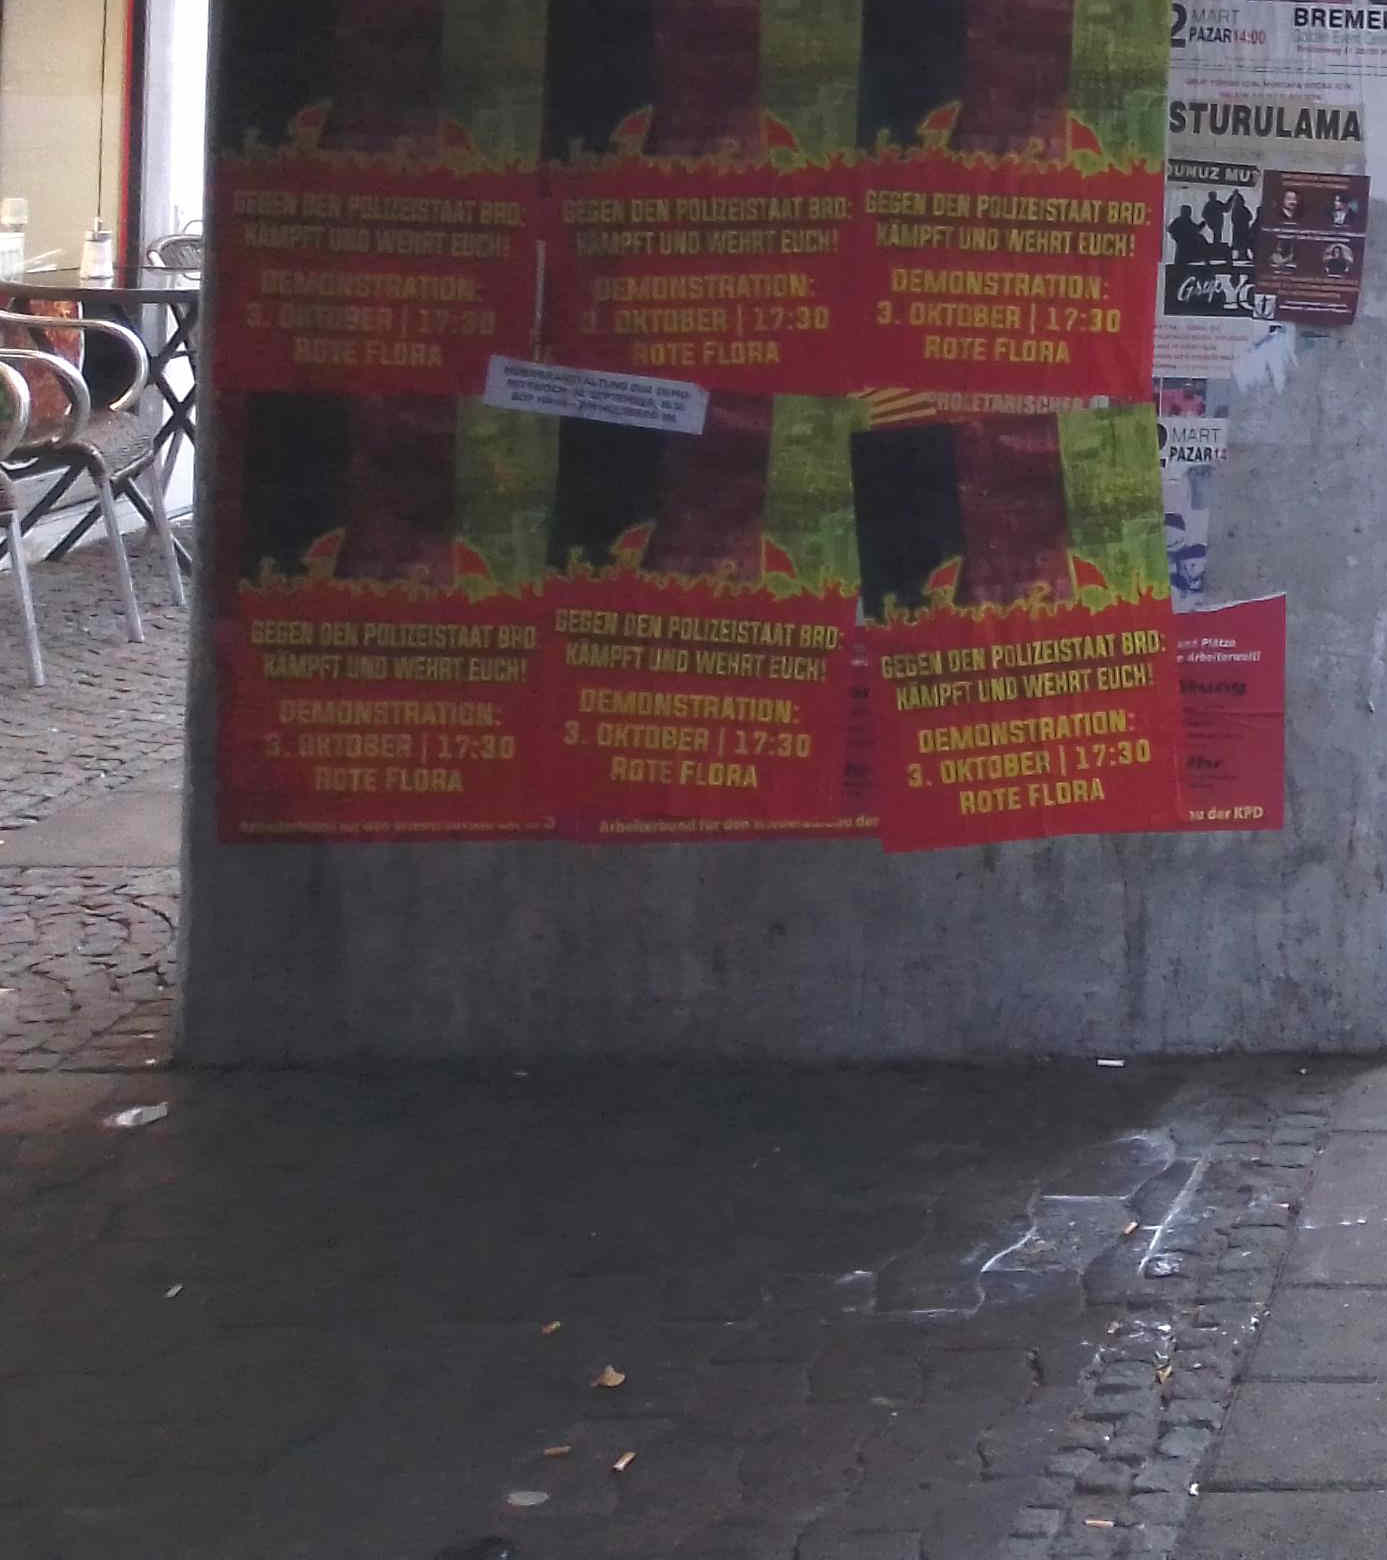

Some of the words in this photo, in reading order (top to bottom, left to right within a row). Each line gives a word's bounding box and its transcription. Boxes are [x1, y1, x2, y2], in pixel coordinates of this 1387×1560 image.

[1191, 9, 1240, 25] MART
[1189, 28, 1231, 43] PAZAR
[1169, 101, 1361, 142] STURULAMA
[562, 199, 624, 223] GEGEN
[631, 198, 670, 222] DEN
[677, 197, 802, 222] POLIZEISTAAT
[864, 190, 926, 215] GEGEN
[932, 192, 970, 218] DEN
[977, 194, 1100, 223] POLIZEISTAAT
[660, 231, 700, 255] UND
[706, 230, 775, 254] WEHRT
[781, 228, 840, 253] EUCH!
[960, 228, 998, 251] UND
[1006, 229, 1072, 253] WEHRT
[1078, 232, 1135, 257] EUCH!
[593, 273, 816, 301] DEMONSTRATION:
[891, 268, 1110, 300] DEMONSTRATION:
[615, 308, 726, 334] OKTOBER
[754, 306, 830, 330] 17:30
[876, 300, 900, 326] 3.
[910, 302, 1020, 329] OKTOBER
[1048, 308, 1120, 332] 17:30
[632, 341, 695, 366] ROTE
[703, 340, 780, 366] FLORA
[924, 336, 987, 360] ROTE
[994, 338, 1070, 364] FLORA
[1172, 427, 1222, 443] MART
[1169, 447, 1212, 462] PAZAR
[555, 609, 618, 635] GEGEN
[624, 612, 662, 638] DEN
[668, 616, 795, 647] POLIZEISTAAT
[650, 647, 688, 672] UND
[696, 650, 765, 677] WEHRT
[769, 656, 827, 681] EUCH!
[881, 651, 942, 679] GEGEN
[949, 648, 985, 672] DEN
[991, 634, 1115, 670] POLIZEISTAAT
[1121, 630, 1166, 656] BRD:
[979, 676, 1017, 702] UND
[1022, 670, 1091, 698] WEHRT
[1098, 663, 1153, 690] EUCH!
[580, 688, 800, 724] DEMONSTRATION:
[563, 720, 589, 745] 3.
[597, 722, 710, 752] OKTOBER
[736, 730, 811, 758] 17:30
[918, 710, 1135, 754] DEMONSTRATION:
[610, 756, 672, 783] ROTE
[680, 760, 757, 789] FLORA
[907, 763, 932, 788] 3.
[940, 750, 1050, 784] OKTOBER
[1076, 739, 1150, 770] 17:30
[960, 787, 1020, 815] ROTE
[1028, 778, 1104, 808] FLORA
[1233, 806, 1264, 820] KPD
